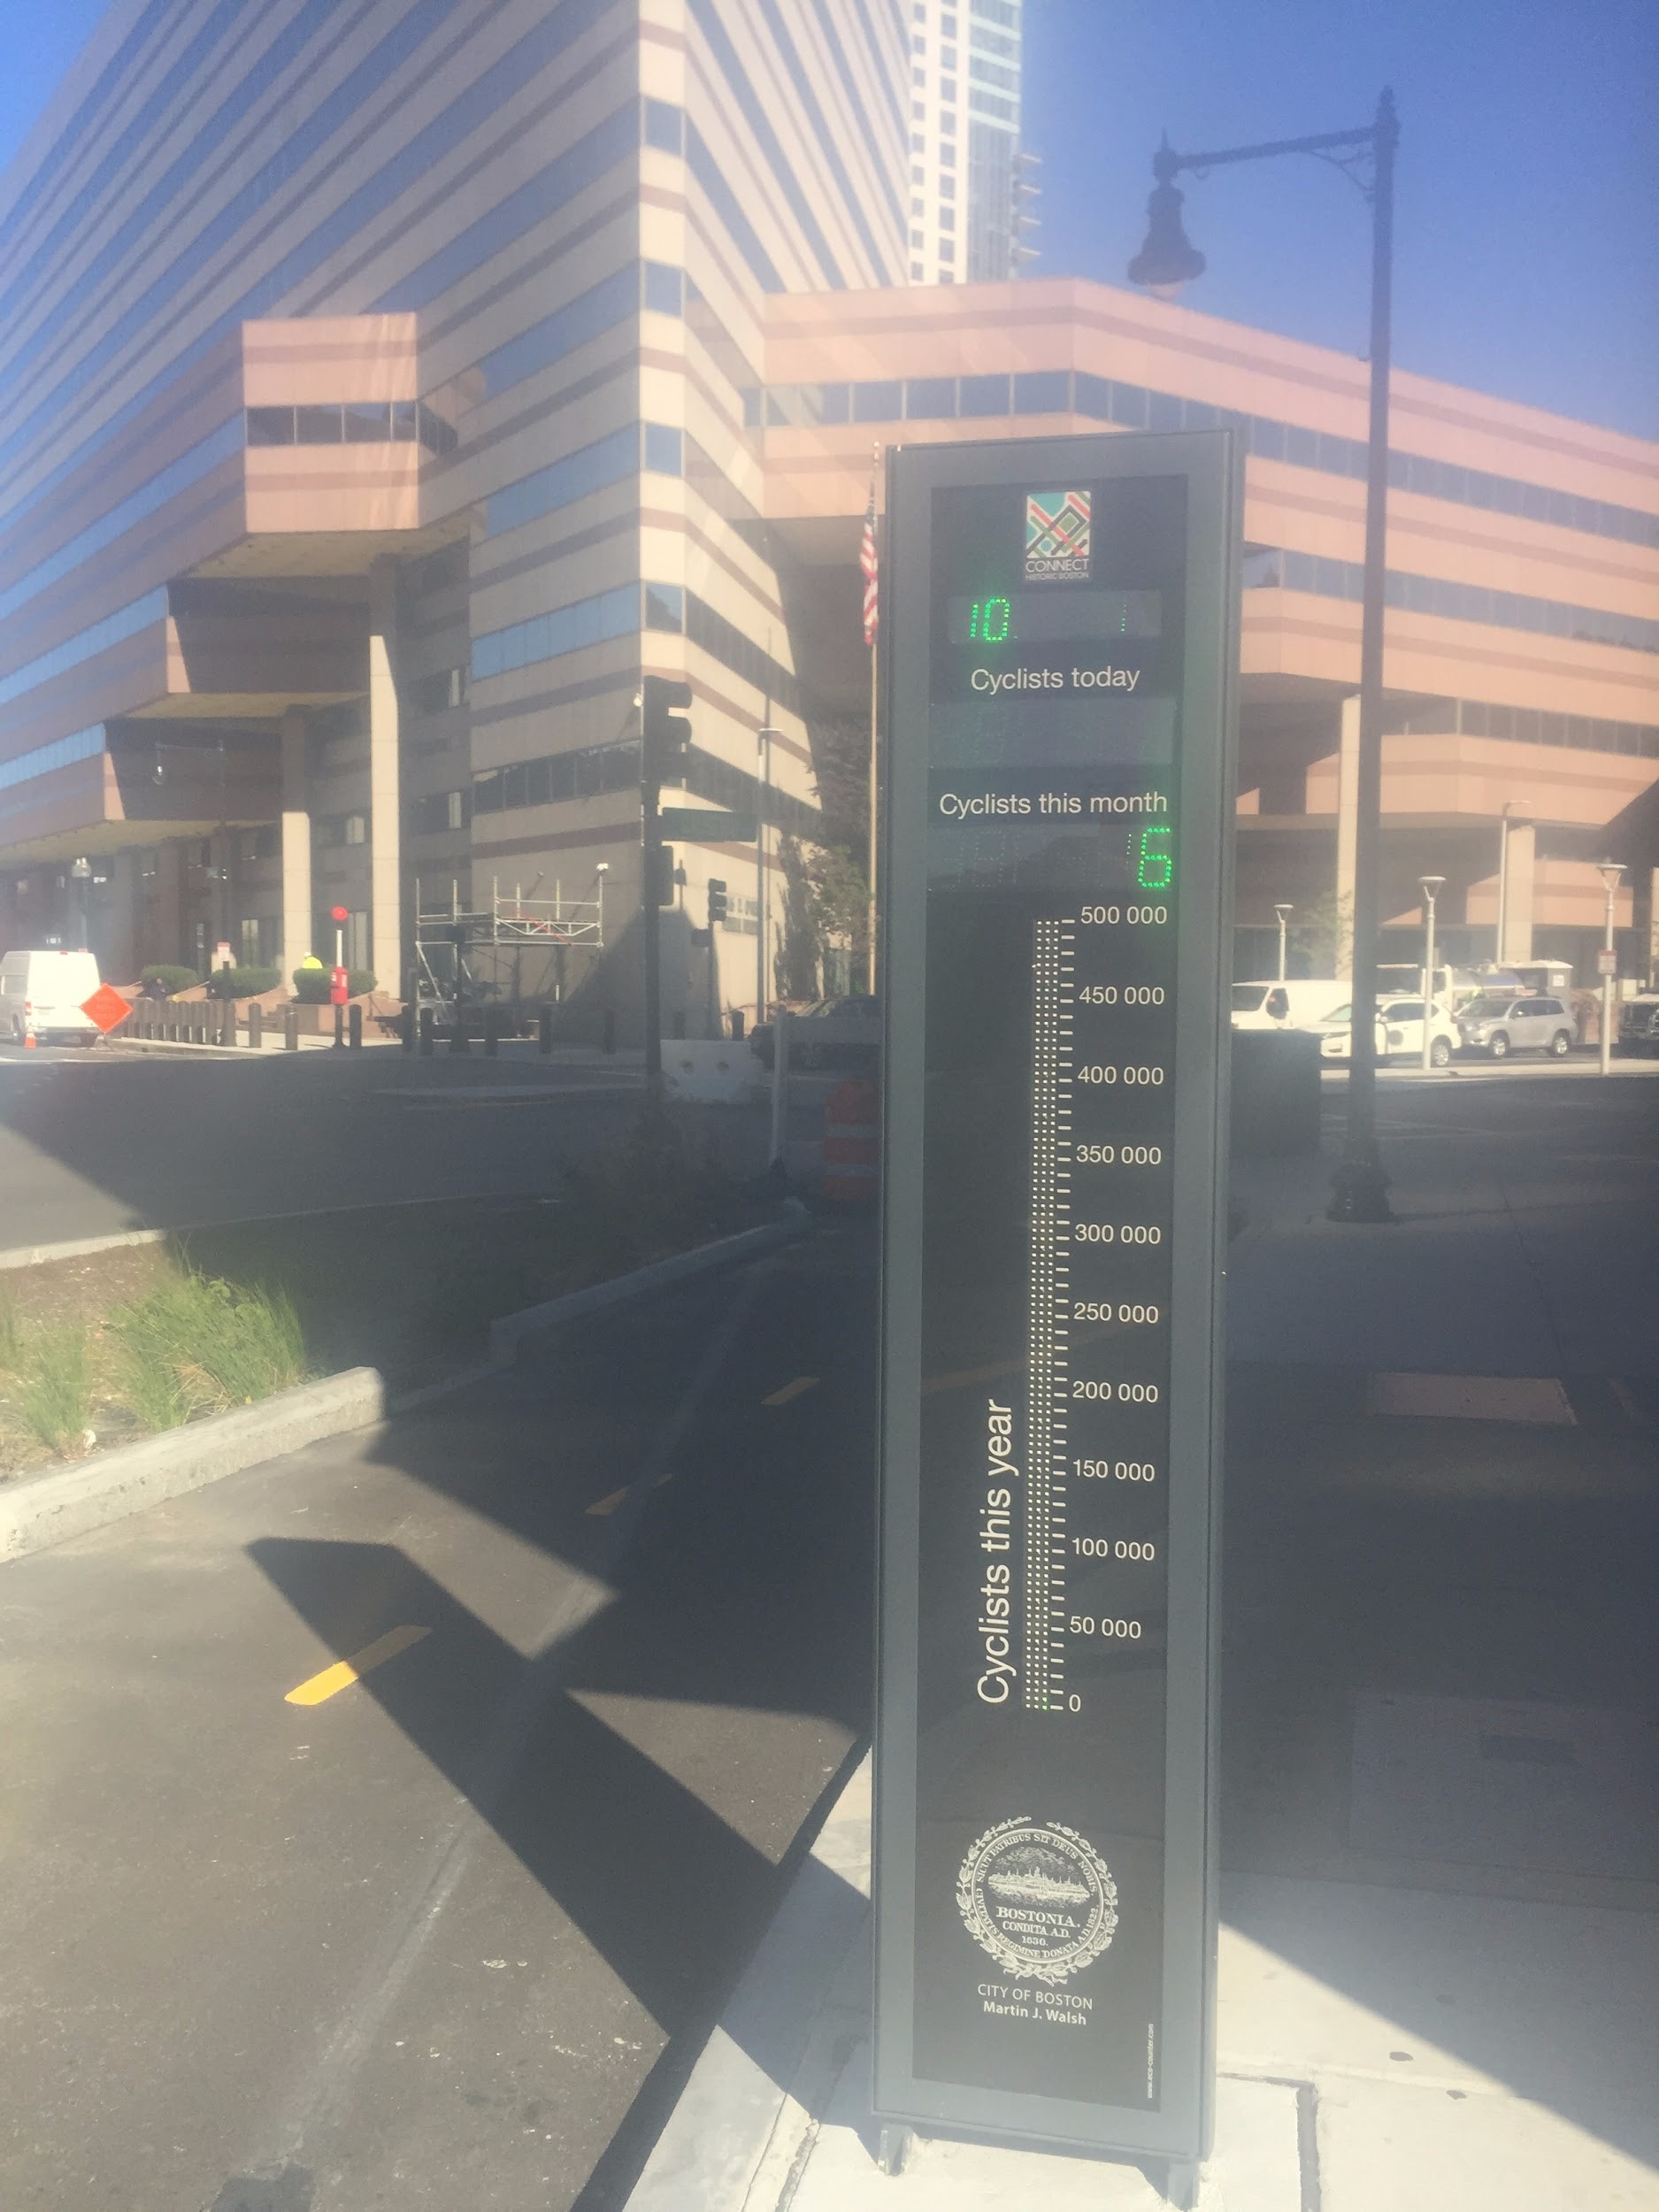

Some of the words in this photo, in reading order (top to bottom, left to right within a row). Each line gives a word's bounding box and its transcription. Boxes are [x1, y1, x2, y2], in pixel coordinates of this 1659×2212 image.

[1025, 558, 1090, 572] CONNECT
[972, 668, 1063, 695] Cyclists
[1071, 665, 1140, 691] today
[940, 794, 1031, 819] Cyclists
[1039, 793, 1081, 813] this
[1091, 792, 1166, 812] month
[1081, 907, 1119, 924] 500
[1127, 907, 1166, 924] 000
[1079, 987, 1117, 1003] 450
[1125, 987, 1164, 1004] 000
[1078, 1066, 1116, 1083] 400
[1124, 1067, 1164, 1085] 000
[1077, 1145, 1114, 1163] 350
[1122, 1147, 1161, 1164] 000
[1075, 1224, 1113, 1241] 300
[1121, 1225, 1160, 1244] 000
[1074, 1302, 1111, 1321] 250
[1119, 1305, 1158, 1323] 000
[1073, 1381, 1110, 1400] 200
[1118, 1384, 1157, 1402] 000
[988, 1399, 1018, 1476] year
[1073, 1459, 1108, 1478] 150
[1116, 1463, 1155, 1481] 000
[979, 1489, 1010, 1552] this
[1072, 1538, 1108, 1556] 100
[1115, 1541, 1154, 1560] 000
[978, 1565, 1017, 1702] Cyclists
[1070, 1616, 1094, 1634] 50
[1102, 1619, 1141, 1639] 000
[1070, 1694, 1080, 1711] 0
[989, 1833, 1032, 1856] PATRIBUS
[1052, 1839, 1079, 1859] DEUS
[1002, 1921, 1049, 1936] CONDITA
[996, 1932, 1041, 1958] REGIMINE
[1042, 1939, 1079, 1958] DONATA
[978, 1984, 1009, 1999] CITY
[1012, 1988, 1031, 2001] OF
[1035, 1991, 1093, 2010] BOSTON
[983, 2001, 1029, 2017] Martin
[1032, 2007, 1042, 2020] J.
[1046, 2009, 1087, 2025] Walsh
